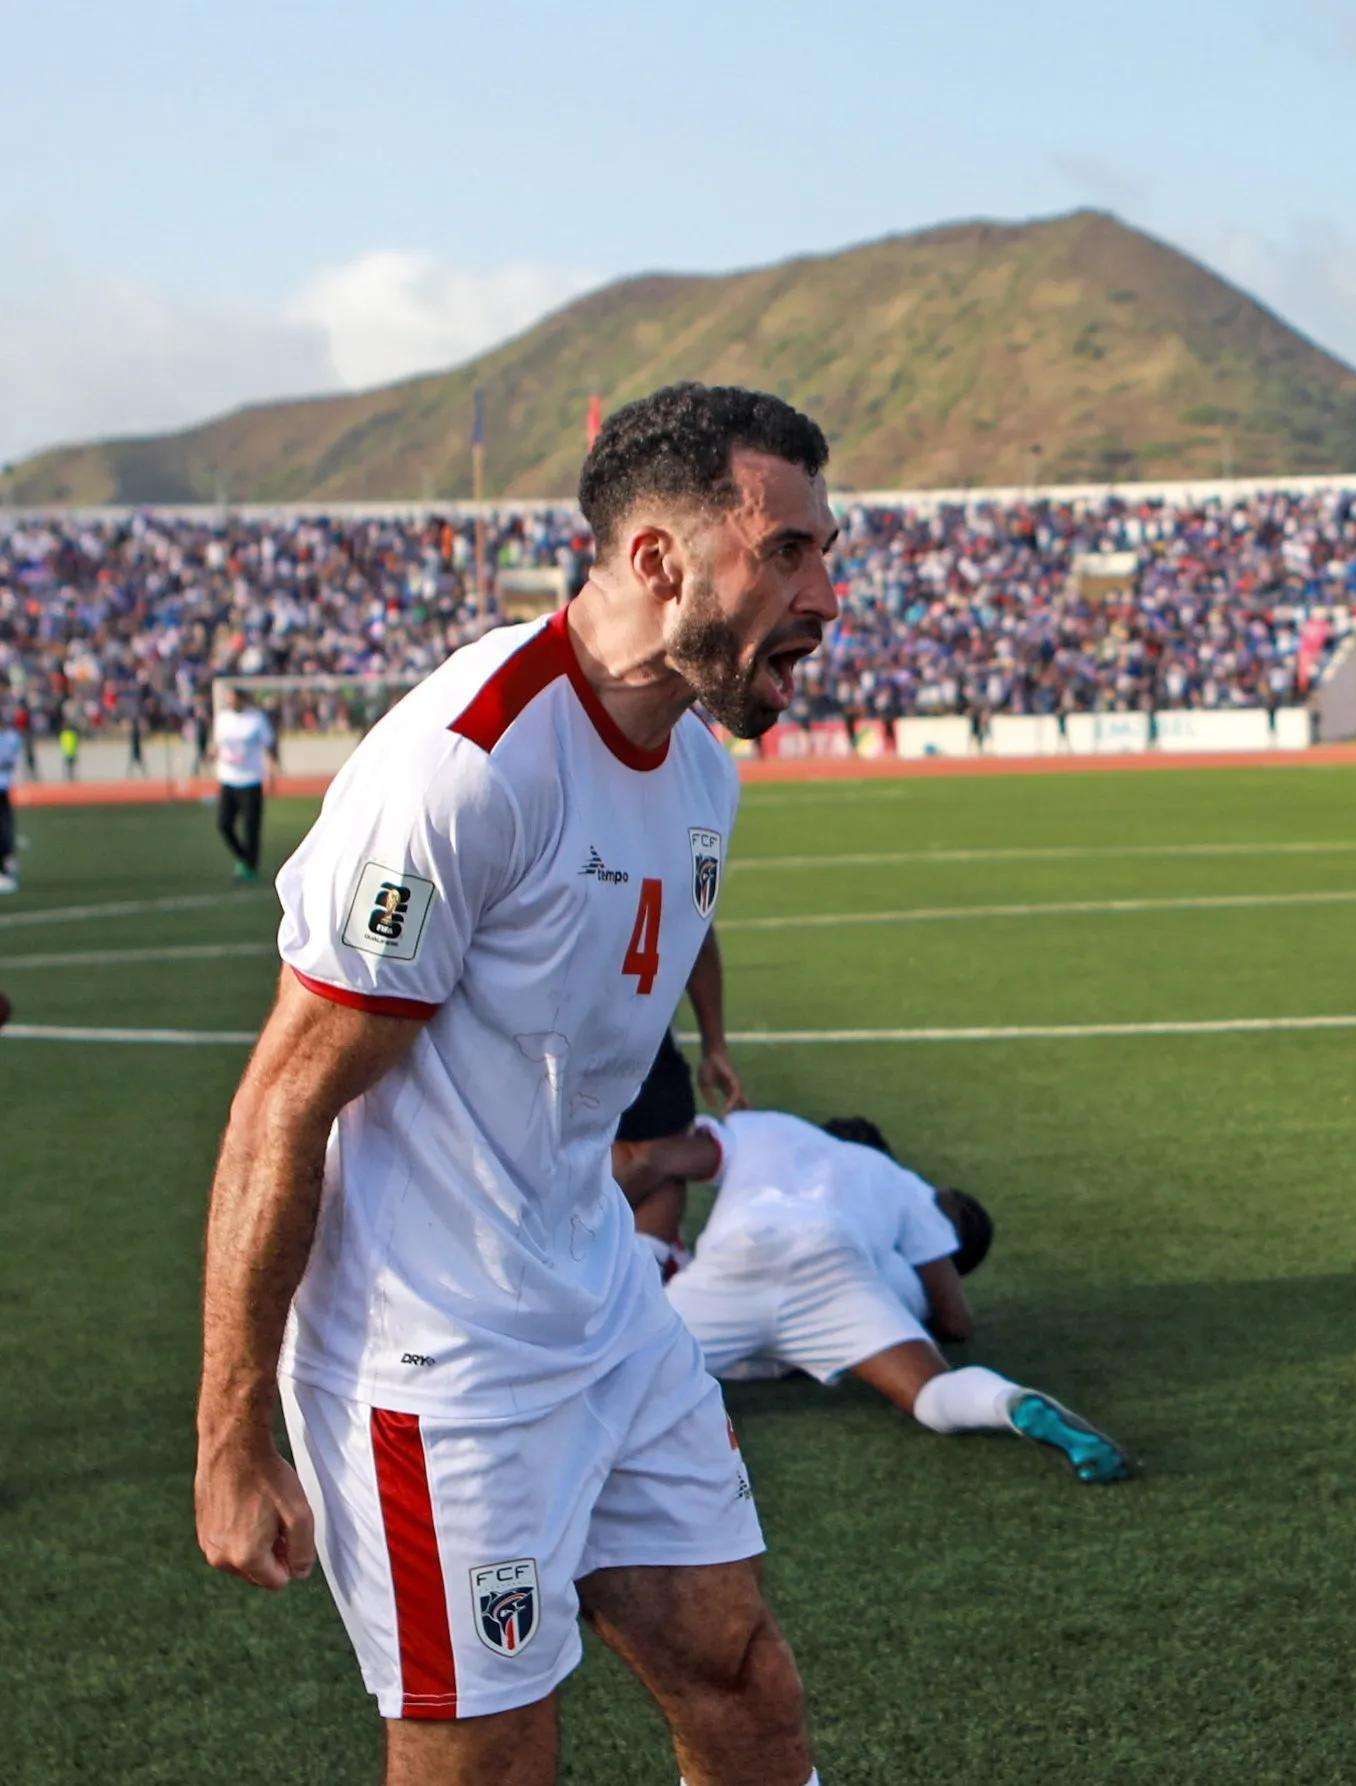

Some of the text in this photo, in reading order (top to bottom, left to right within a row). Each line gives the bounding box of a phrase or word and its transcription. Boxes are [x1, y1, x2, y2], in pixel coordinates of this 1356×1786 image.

[692, 832, 717, 848] FCF
[598, 868, 629, 884] tempo
[621, 878, 662, 995] 4
[477, 1565, 530, 1586] FCF
